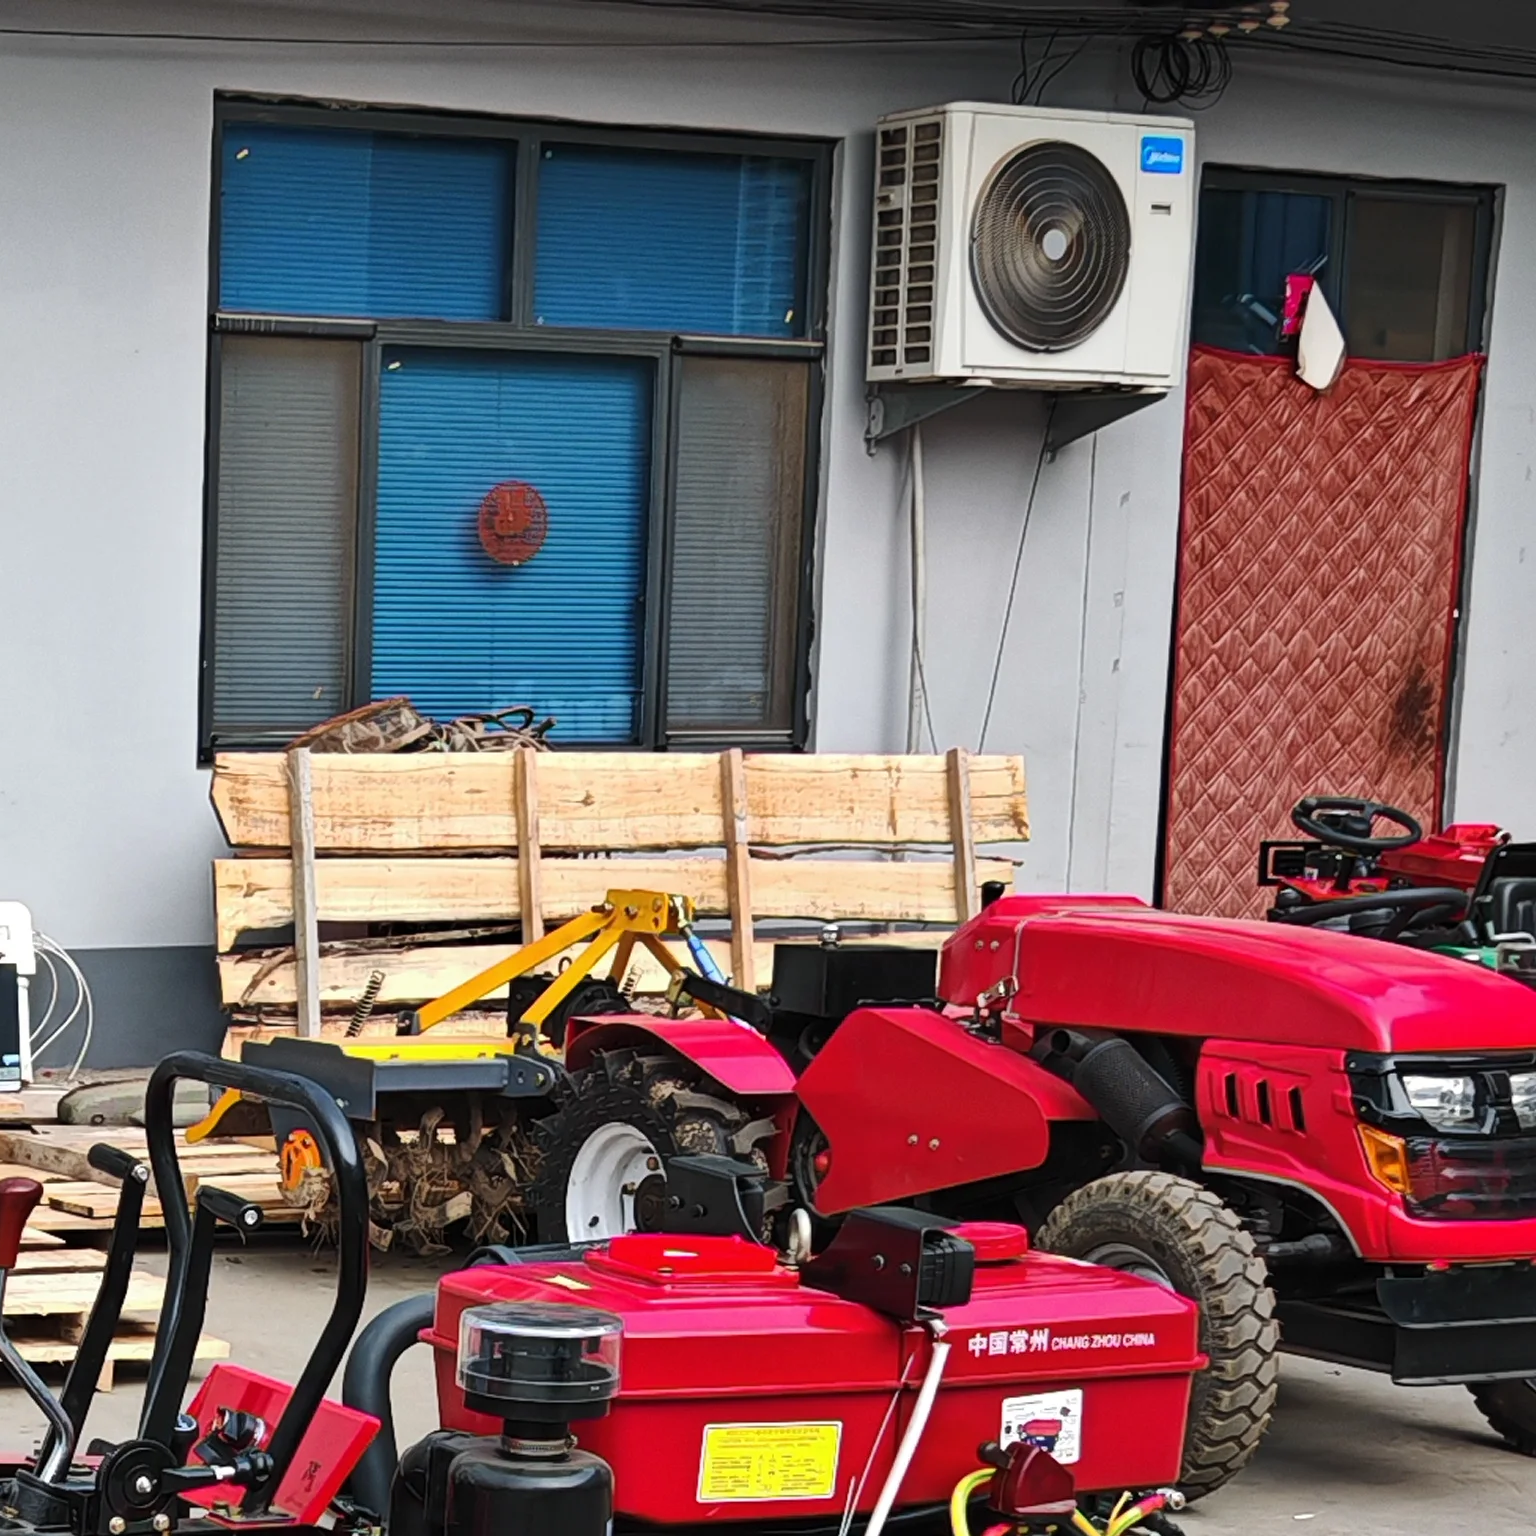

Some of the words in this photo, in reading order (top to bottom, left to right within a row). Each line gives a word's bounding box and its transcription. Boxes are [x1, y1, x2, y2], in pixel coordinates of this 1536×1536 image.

[968, 1328, 1049, 1357] 中国常州
[1051, 1336, 1090, 1350] CHANG
[1091, 1334, 1121, 1348] ZHOU
[1123, 1333, 1155, 1347] CHINA
